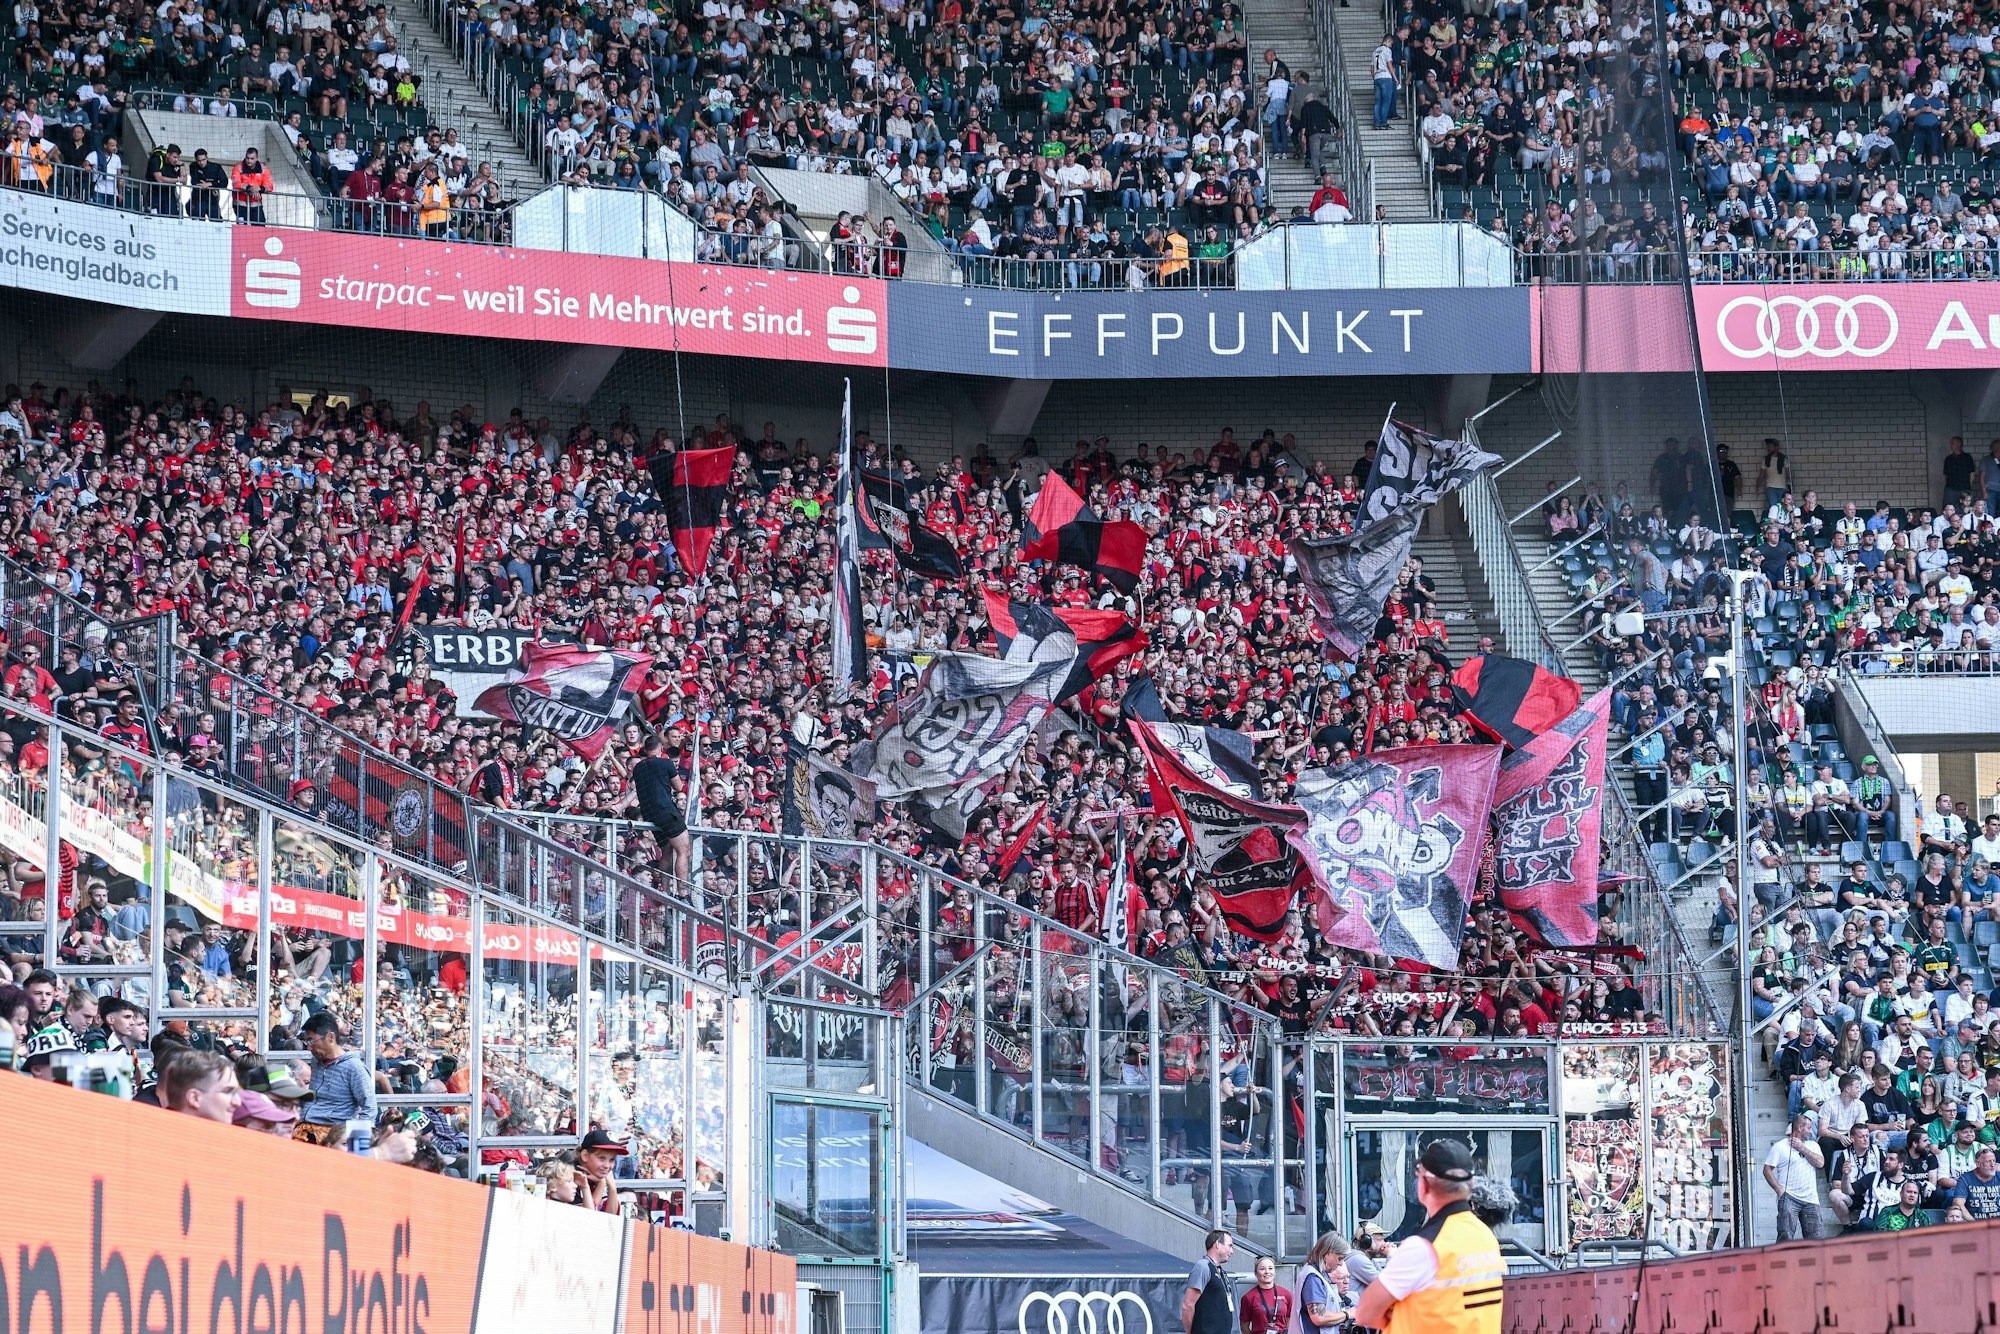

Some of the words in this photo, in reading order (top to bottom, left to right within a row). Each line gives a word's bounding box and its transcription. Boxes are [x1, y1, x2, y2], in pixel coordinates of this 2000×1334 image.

[2, 213, 106, 251] Services
[113, 238, 157, 260] aus
[0, 246, 179, 291] chengladbach
[319, 274, 432, 309] starpac
[462, 286, 525, 314] weil
[534, 287, 580, 318] Sie
[588, 292, 734, 331] Mehrwert
[742, 305, 811, 337] sind.
[1925, 300, 2000, 350] A
[988, 309, 1424, 357] EFFPUNKT
[1257, 955, 1310, 975] CHAOS
[1315, 965, 1343, 979] 513
[1372, 991, 1422, 1006] CHAOS
[1561, 1022, 1613, 1035] CHAOS
[1621, 1022, 1648, 1034] 513
[0, 1243, 63, 1334] n
[208, 1195, 307, 1334] den
[322, 1209, 431, 1334] Profis
